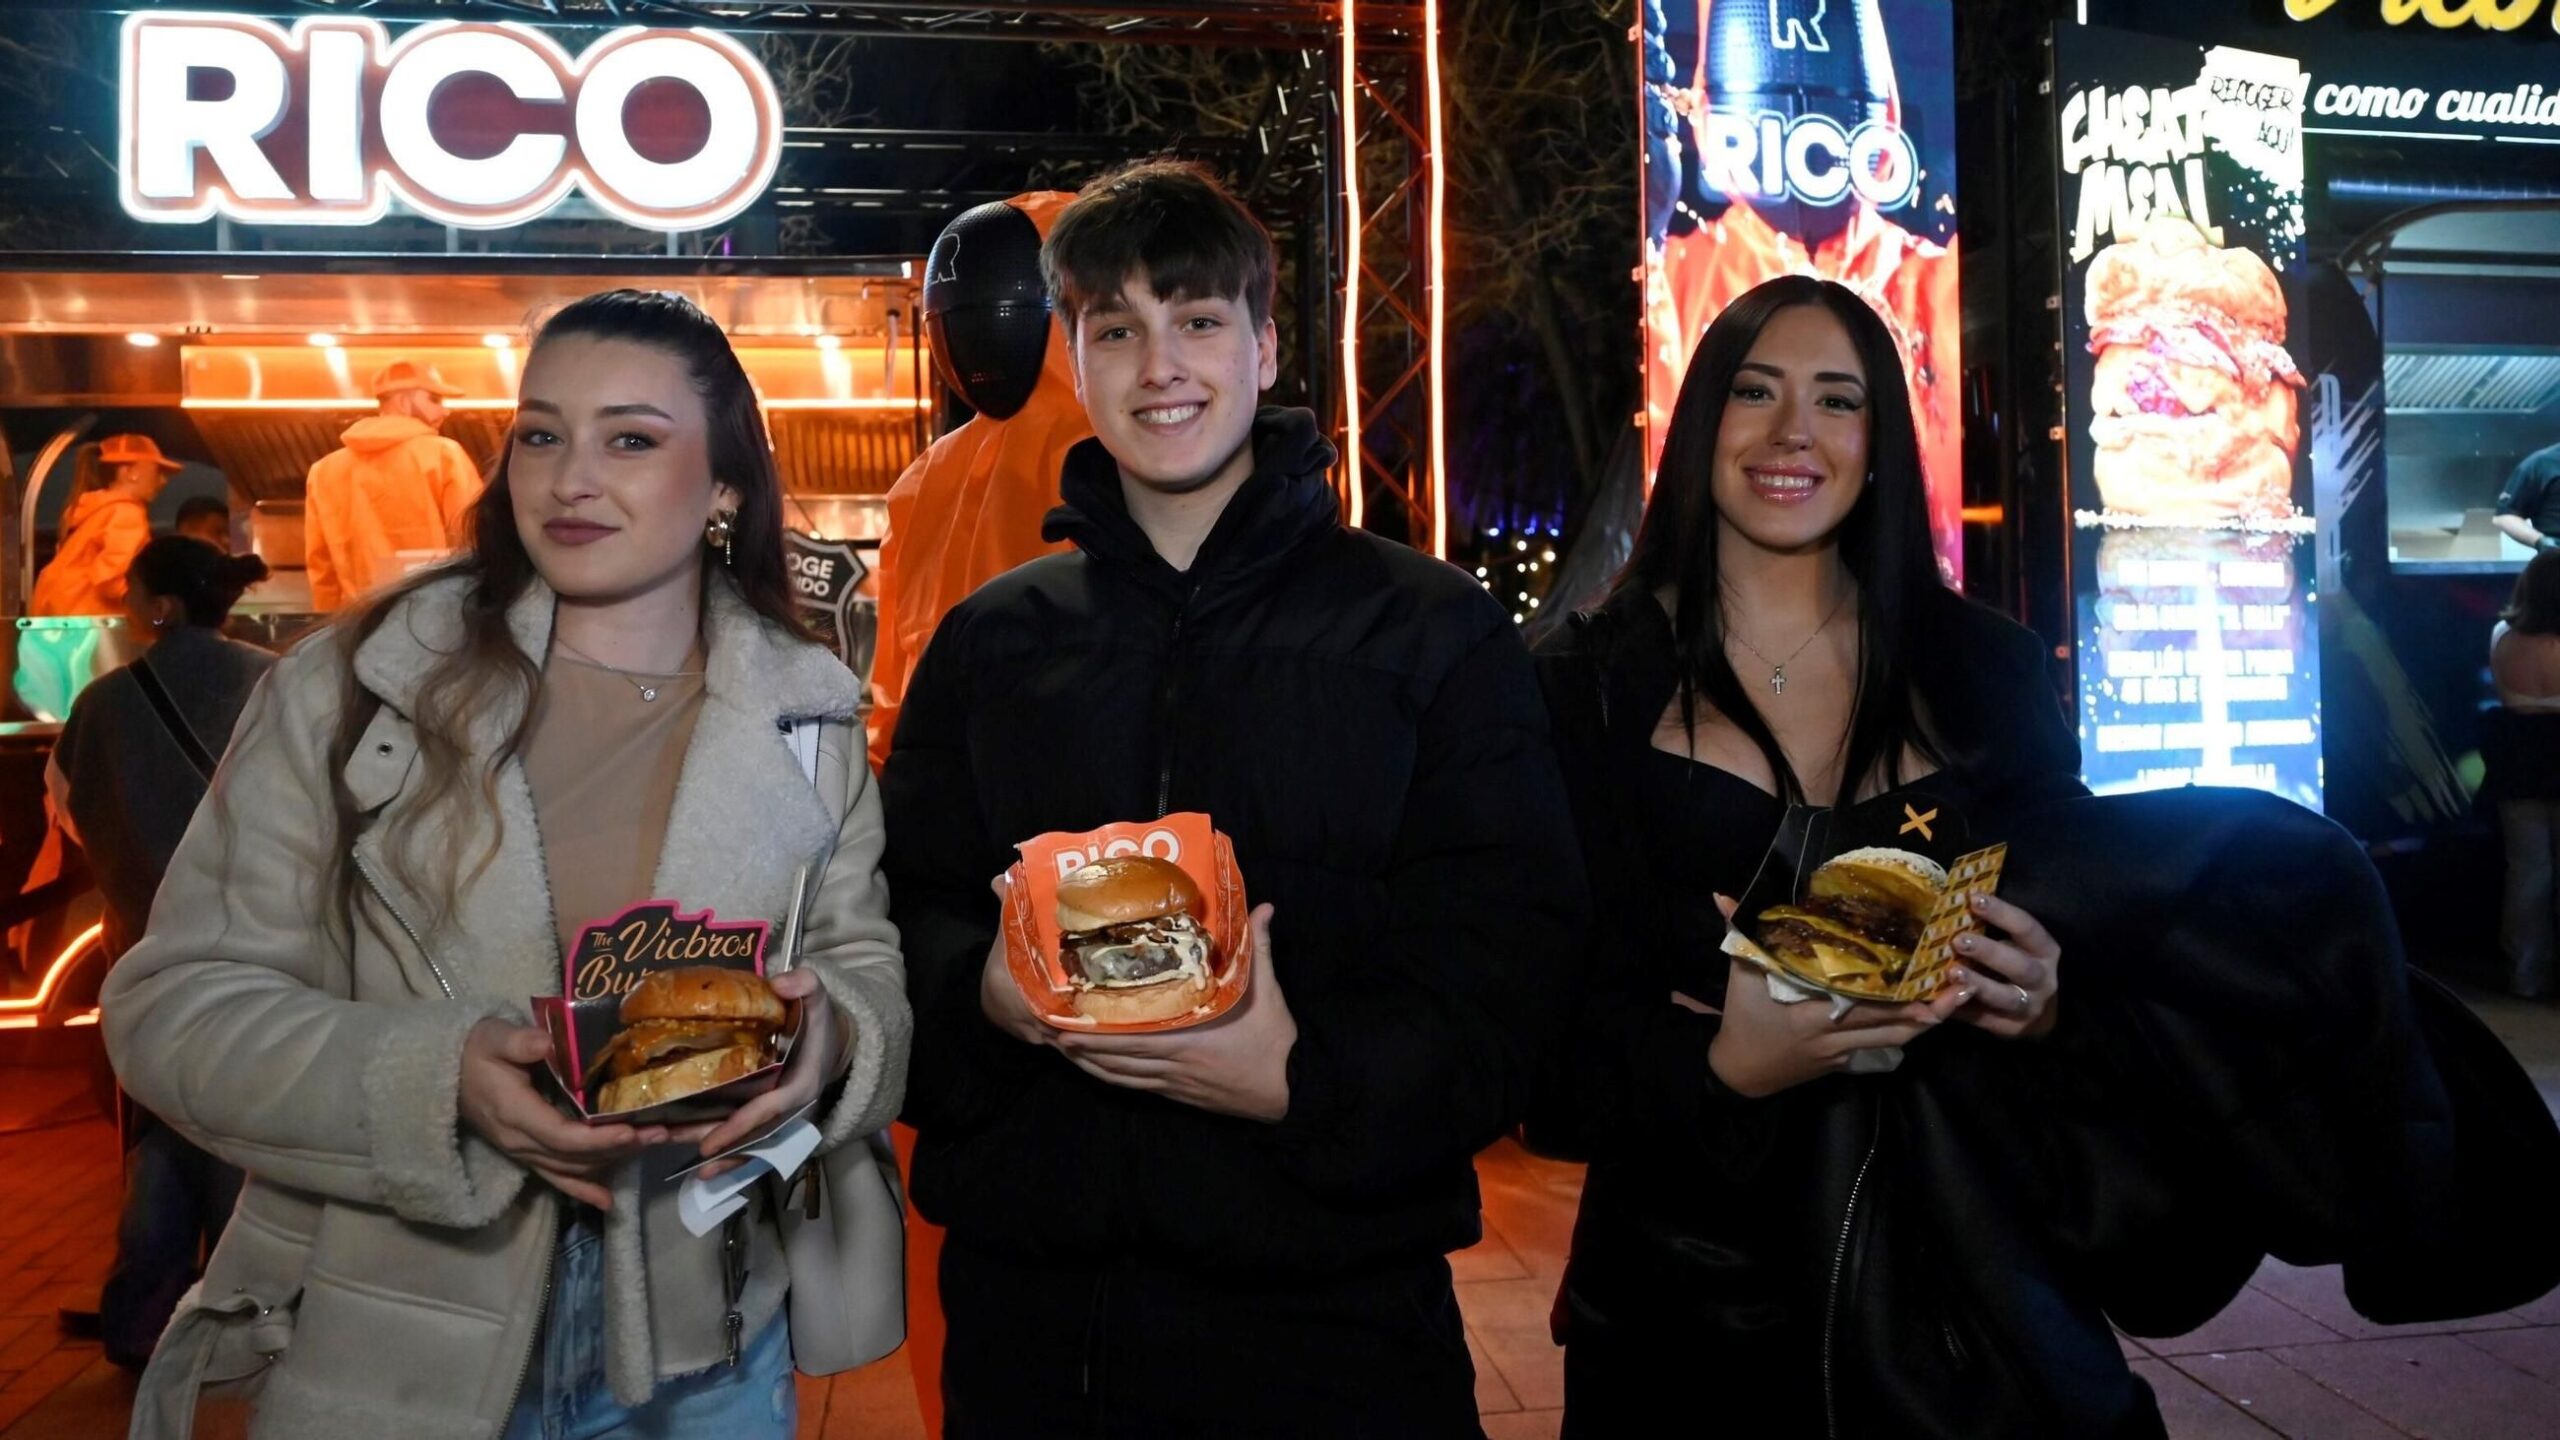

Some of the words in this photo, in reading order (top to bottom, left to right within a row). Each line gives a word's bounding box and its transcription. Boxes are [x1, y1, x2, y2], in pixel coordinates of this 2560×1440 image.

[137, 25, 760, 207] RICO
[2060, 85, 2206, 174] CHEAT
[2313, 83, 2430, 119] como
[1705, 113, 1914, 205] RICO
[592, 931, 613, 948] The
[618, 917, 755, 963] Vicbros
